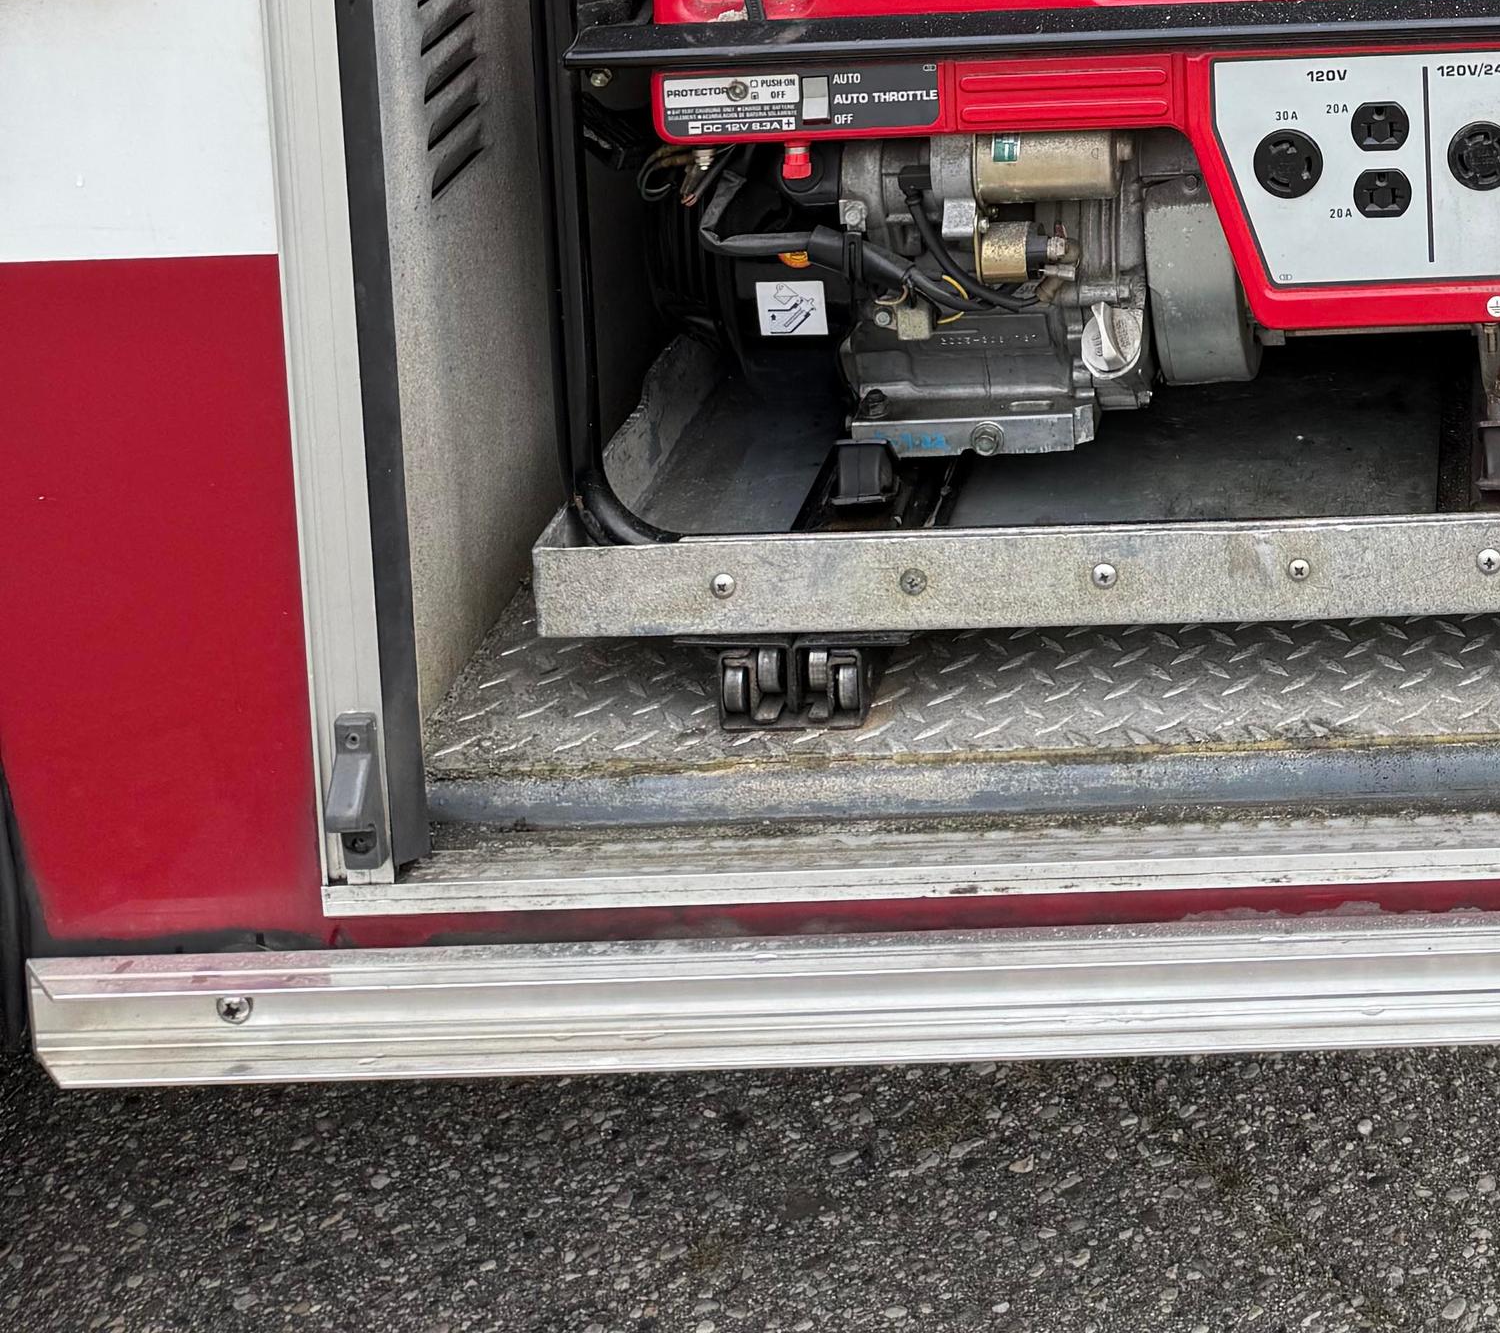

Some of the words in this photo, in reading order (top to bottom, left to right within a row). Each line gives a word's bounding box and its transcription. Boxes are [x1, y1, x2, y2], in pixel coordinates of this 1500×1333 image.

[832, 73, 861, 84] AUTO
[1306, 69, 1348, 82] 120V
[666, 87, 728, 98] PROTECTOR
[770, 90, 786, 99] OFF
[834, 93, 869, 105] AUTO
[872, 90, 938, 103] THROTTLE
[834, 114, 853, 125] OFF
[703, 124, 722, 133] DC
[725, 123, 749, 132] 12V
[751, 122, 781, 130] 8.3A
